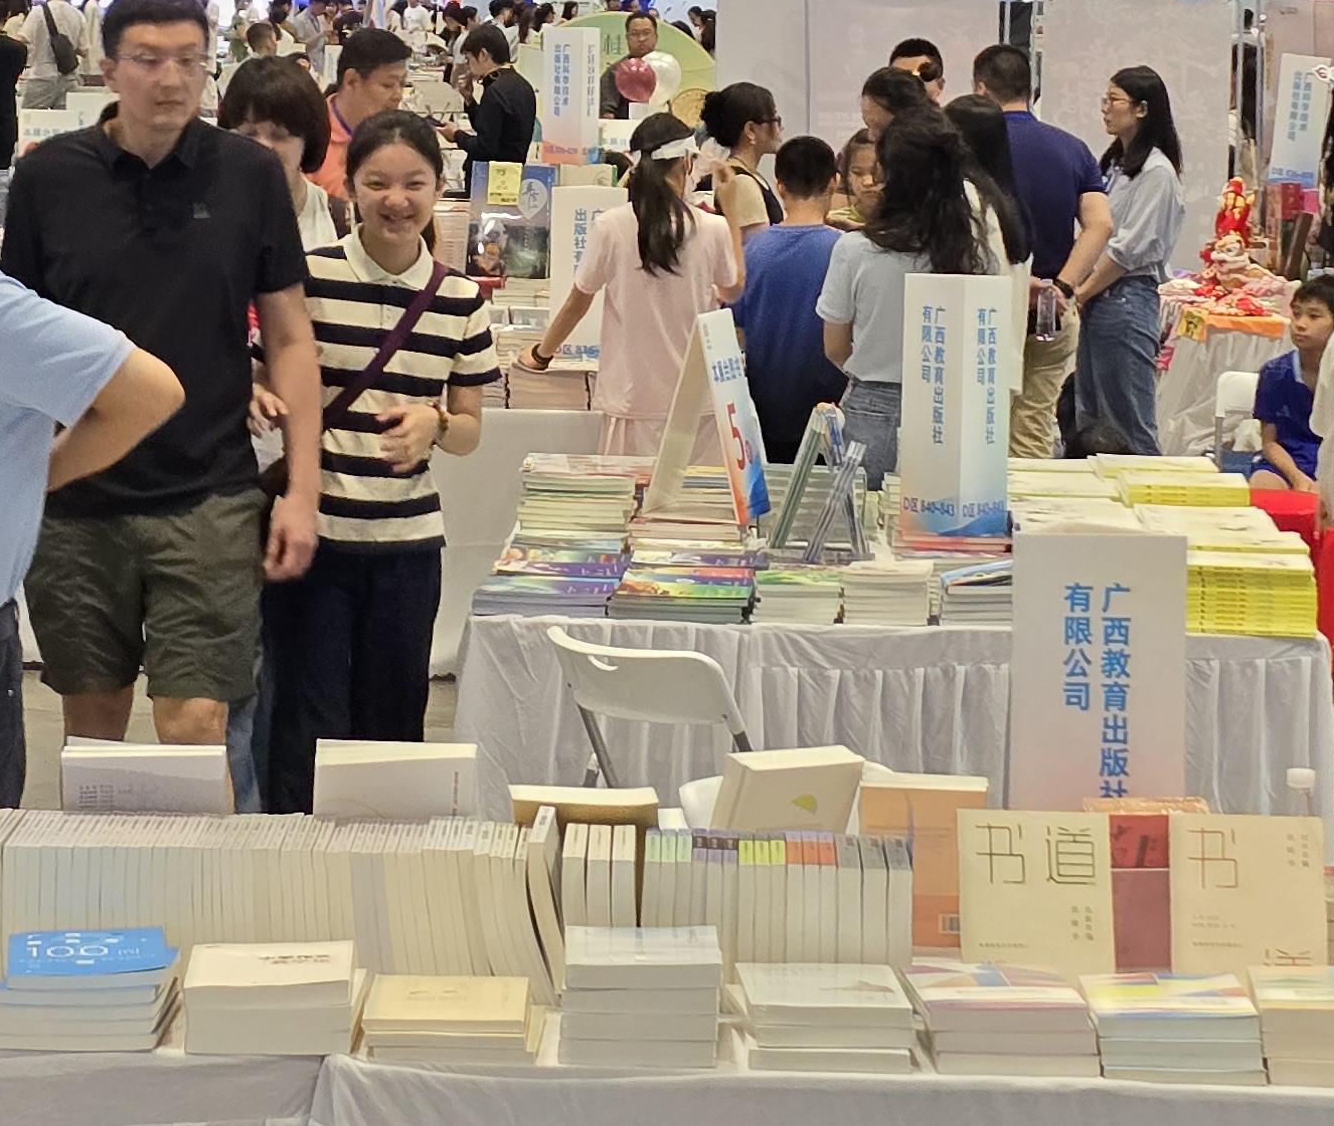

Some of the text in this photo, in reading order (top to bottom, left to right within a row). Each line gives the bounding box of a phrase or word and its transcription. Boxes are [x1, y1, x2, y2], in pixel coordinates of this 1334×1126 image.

[573, 209, 588, 271] 出版社有
[920, 305, 945, 445] 广西教育出版社 有限公司
[975, 307, 998, 445] 广西教育出版社 有限公司
[726, 401, 745, 471] 5
[1063, 582, 1131, 798] 广西教育出版社 有限公司
[975, 823, 1096, 886] 书道
[1187, 827, 1238, 889] 书
[27, 944, 109, 958] 100
